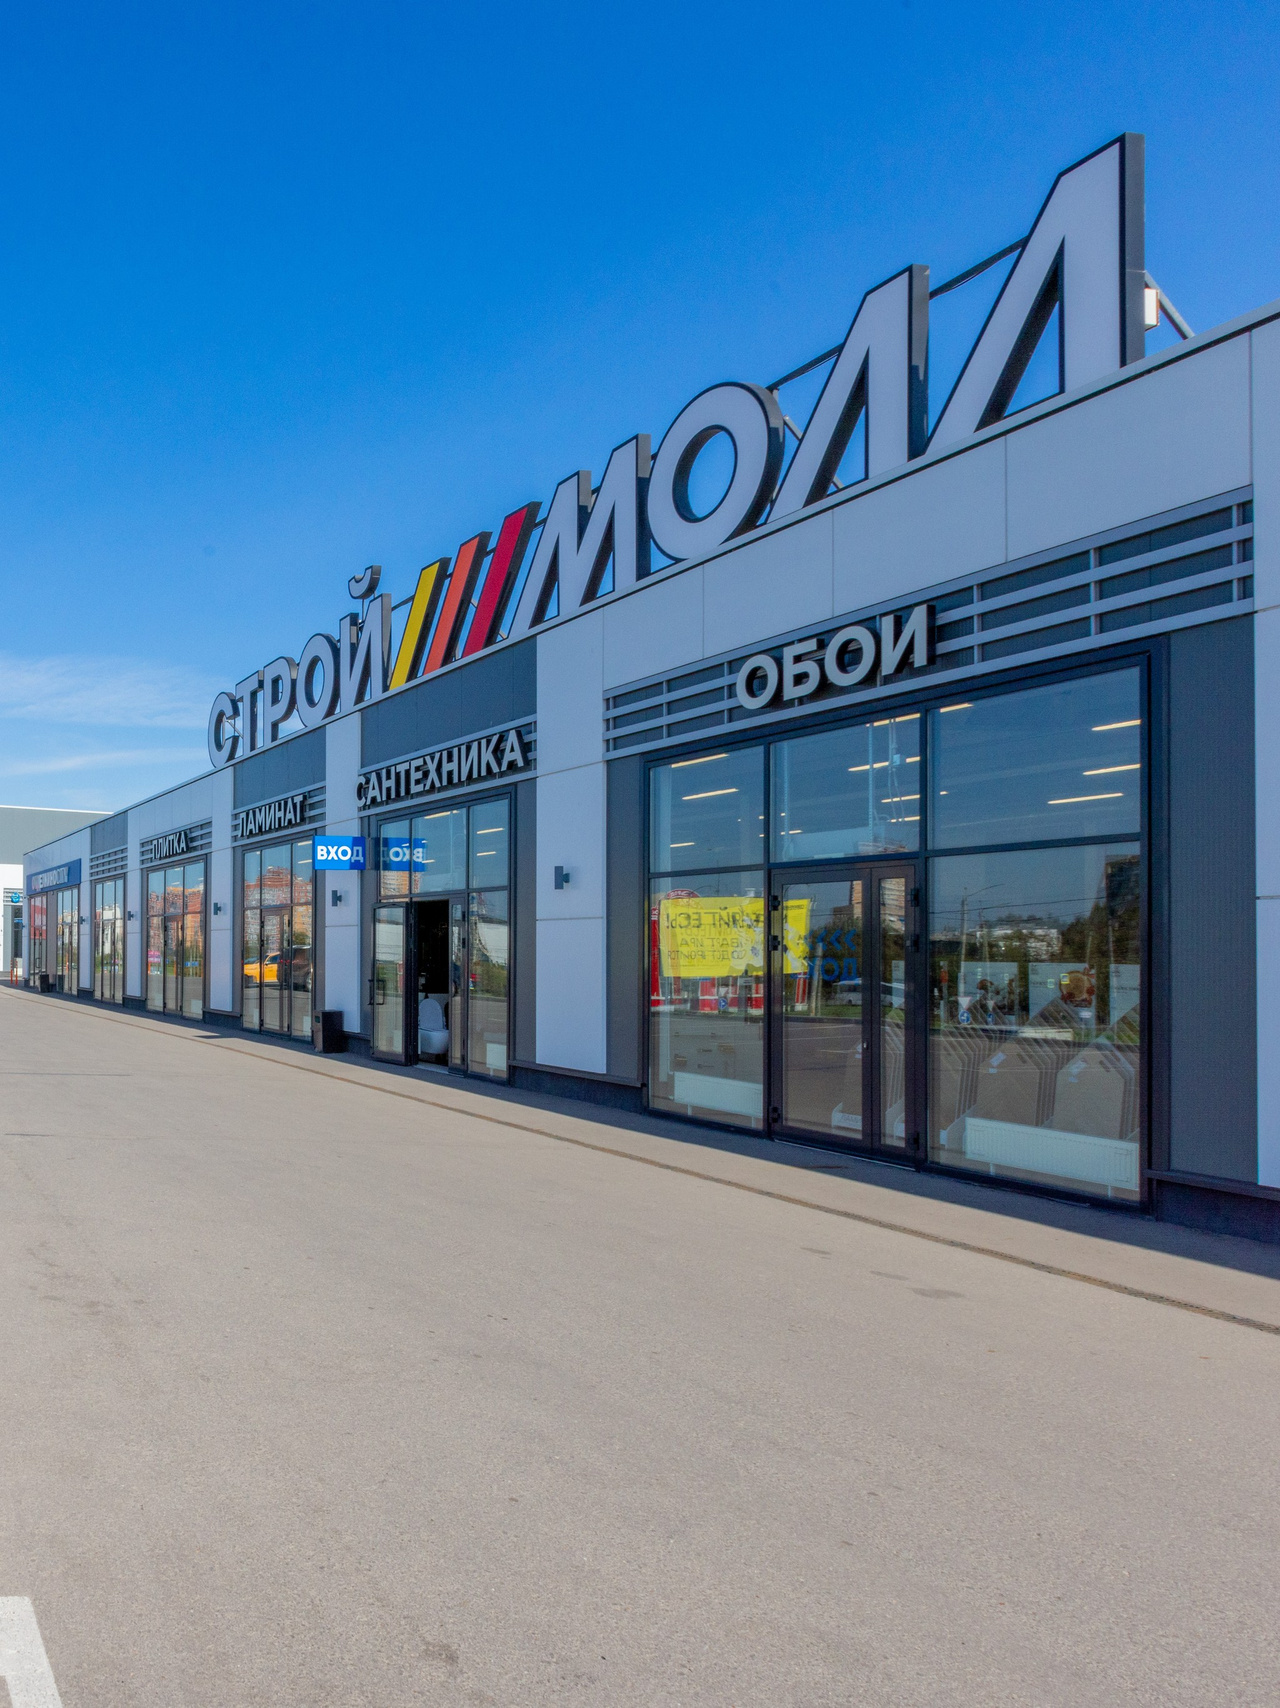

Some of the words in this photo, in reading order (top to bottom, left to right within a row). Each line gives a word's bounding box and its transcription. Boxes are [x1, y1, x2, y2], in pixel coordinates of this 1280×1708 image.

[208, 565, 391, 768] СТРОЙ
[510, 132, 1146, 637] МОЛЛ
[736, 605, 936, 710] ОБОИ
[355, 729, 528, 808] САНТЕХНИКА
[152, 831, 188, 860] ПЛИТКА
[238, 794, 305, 838] ЛАМИНАТ
[316, 845, 364, 863] ВХОД
